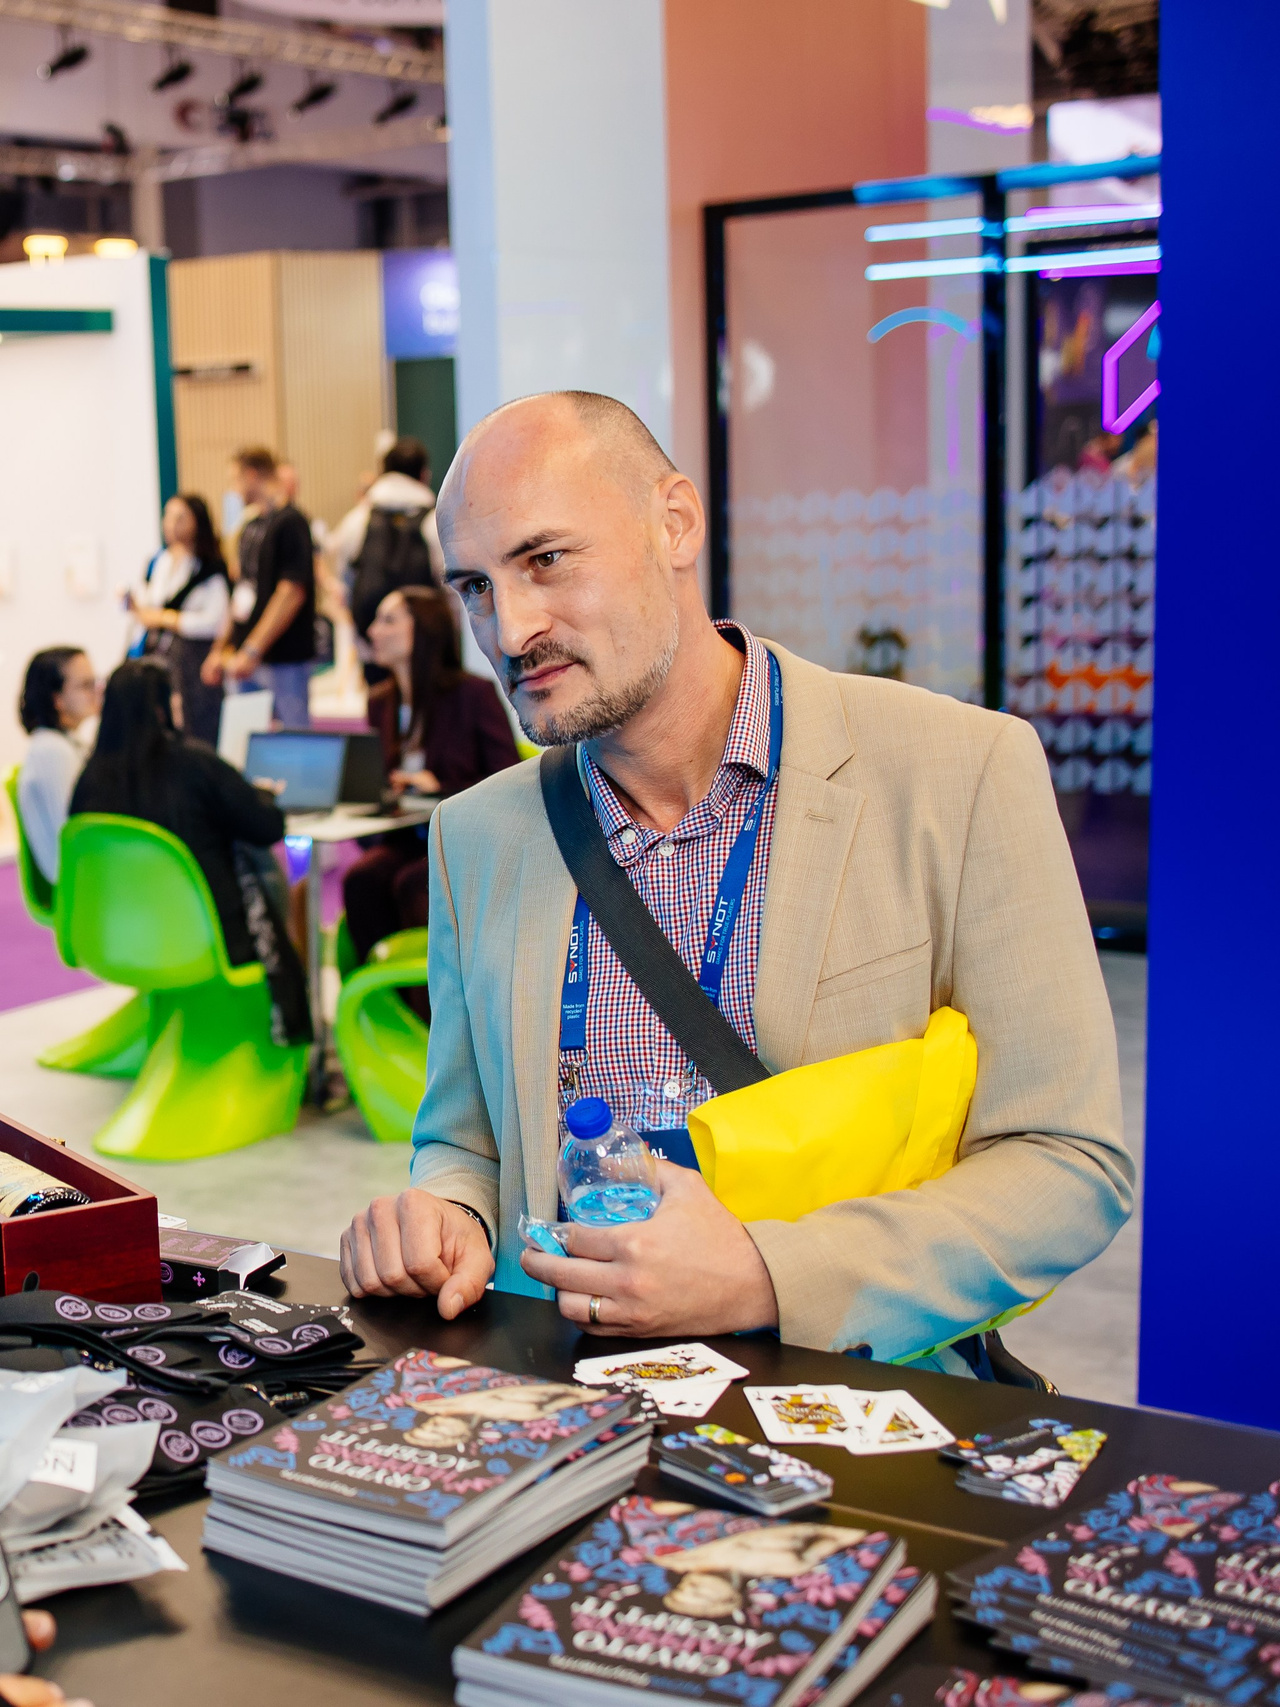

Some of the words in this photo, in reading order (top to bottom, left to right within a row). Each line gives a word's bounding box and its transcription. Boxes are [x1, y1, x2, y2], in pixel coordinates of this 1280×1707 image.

[722, 920, 730, 935] TRUE
[726, 898, 736, 921] PLAYERS
[707, 895, 729, 964] SYNOT
[719, 935, 727, 947] FOR
[568, 925, 580, 984] SYNOT
[307, 1453, 432, 1492] CRYPTO
[572, 1629, 731, 1678] CRYPTO
